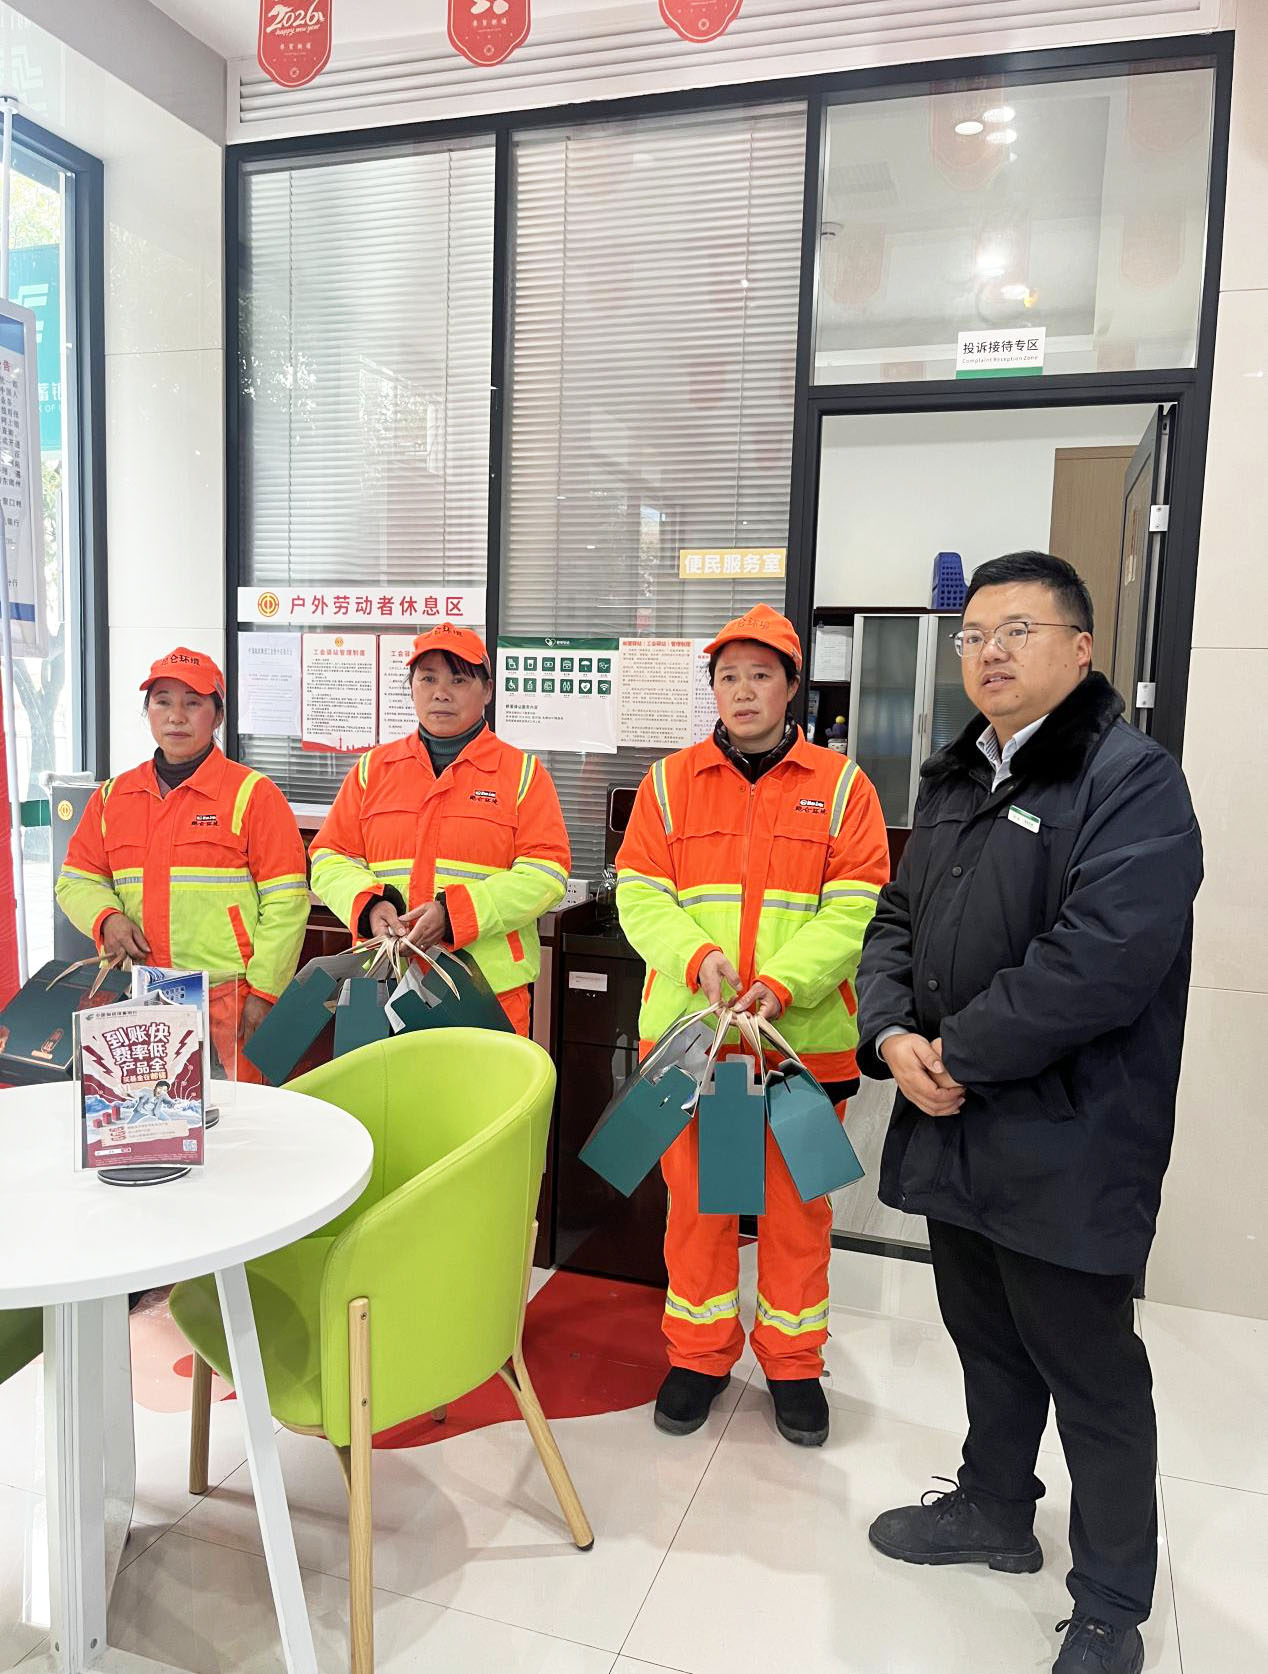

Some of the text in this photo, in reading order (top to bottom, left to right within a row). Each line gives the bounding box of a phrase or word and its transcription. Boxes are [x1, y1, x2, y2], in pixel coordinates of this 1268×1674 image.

[266, 0, 325, 33] 2026
[275, 28, 295, 37] happy
[962, 338, 1039, 355] 投诉接待专区
[962, 357, 992, 365] Complaint
[685, 553, 782, 574] 便民服务室
[290, 594, 464, 617] 户外劳动者休息区
[102, 1022, 170, 1049] 到账快
[111, 1042, 168, 1064] 费率低
[120, 1057, 167, 1077] 产品全
